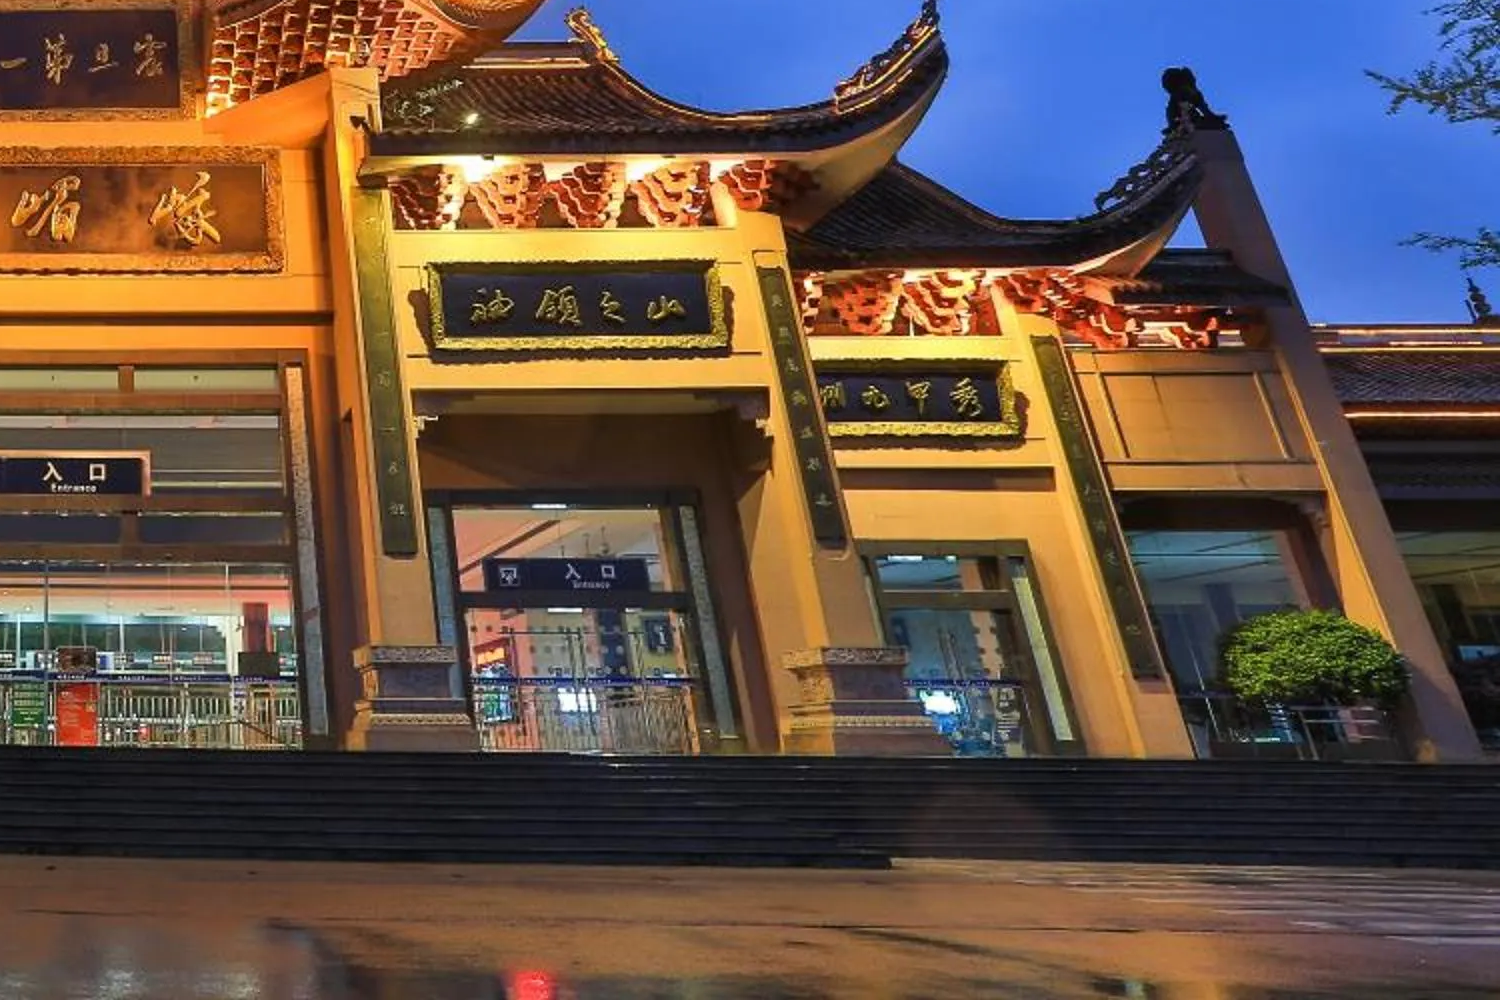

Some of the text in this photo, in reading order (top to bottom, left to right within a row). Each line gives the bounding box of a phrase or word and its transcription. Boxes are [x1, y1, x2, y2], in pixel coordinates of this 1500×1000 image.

[42, 462, 106, 482] 入口
[51, 483, 97, 493] Entrance
[564, 563, 615, 580] 入口
[572, 579, 611, 589] Entrance
